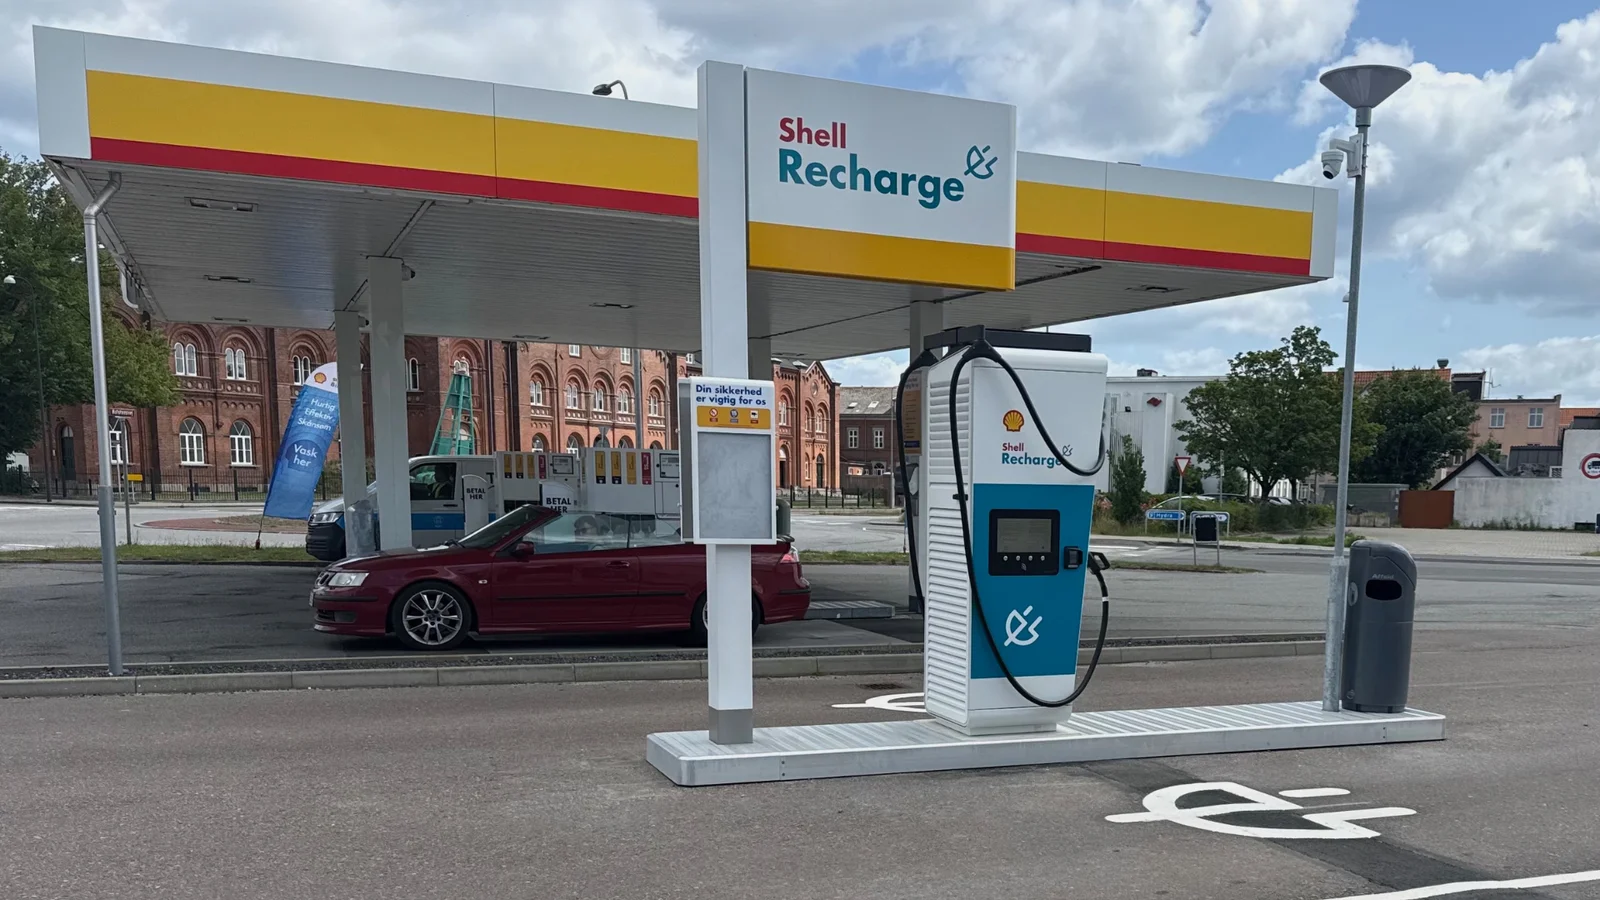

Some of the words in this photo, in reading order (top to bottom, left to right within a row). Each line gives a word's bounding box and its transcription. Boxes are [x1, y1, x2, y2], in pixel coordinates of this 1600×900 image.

[779, 117, 847, 149] Shell
[778, 148, 965, 209] Recharge
[696, 385, 712, 393] Din
[715, 386, 762, 396] sikkerhed
[708, 394, 736, 406] vigtig
[739, 397, 753, 405] for
[294, 444, 318, 458] Vask
[1002, 443, 1024, 451] Shell
[294, 457, 311, 467] her
[1002, 453, 1061, 468] Recharge
[546, 497, 572, 505] BETAL
